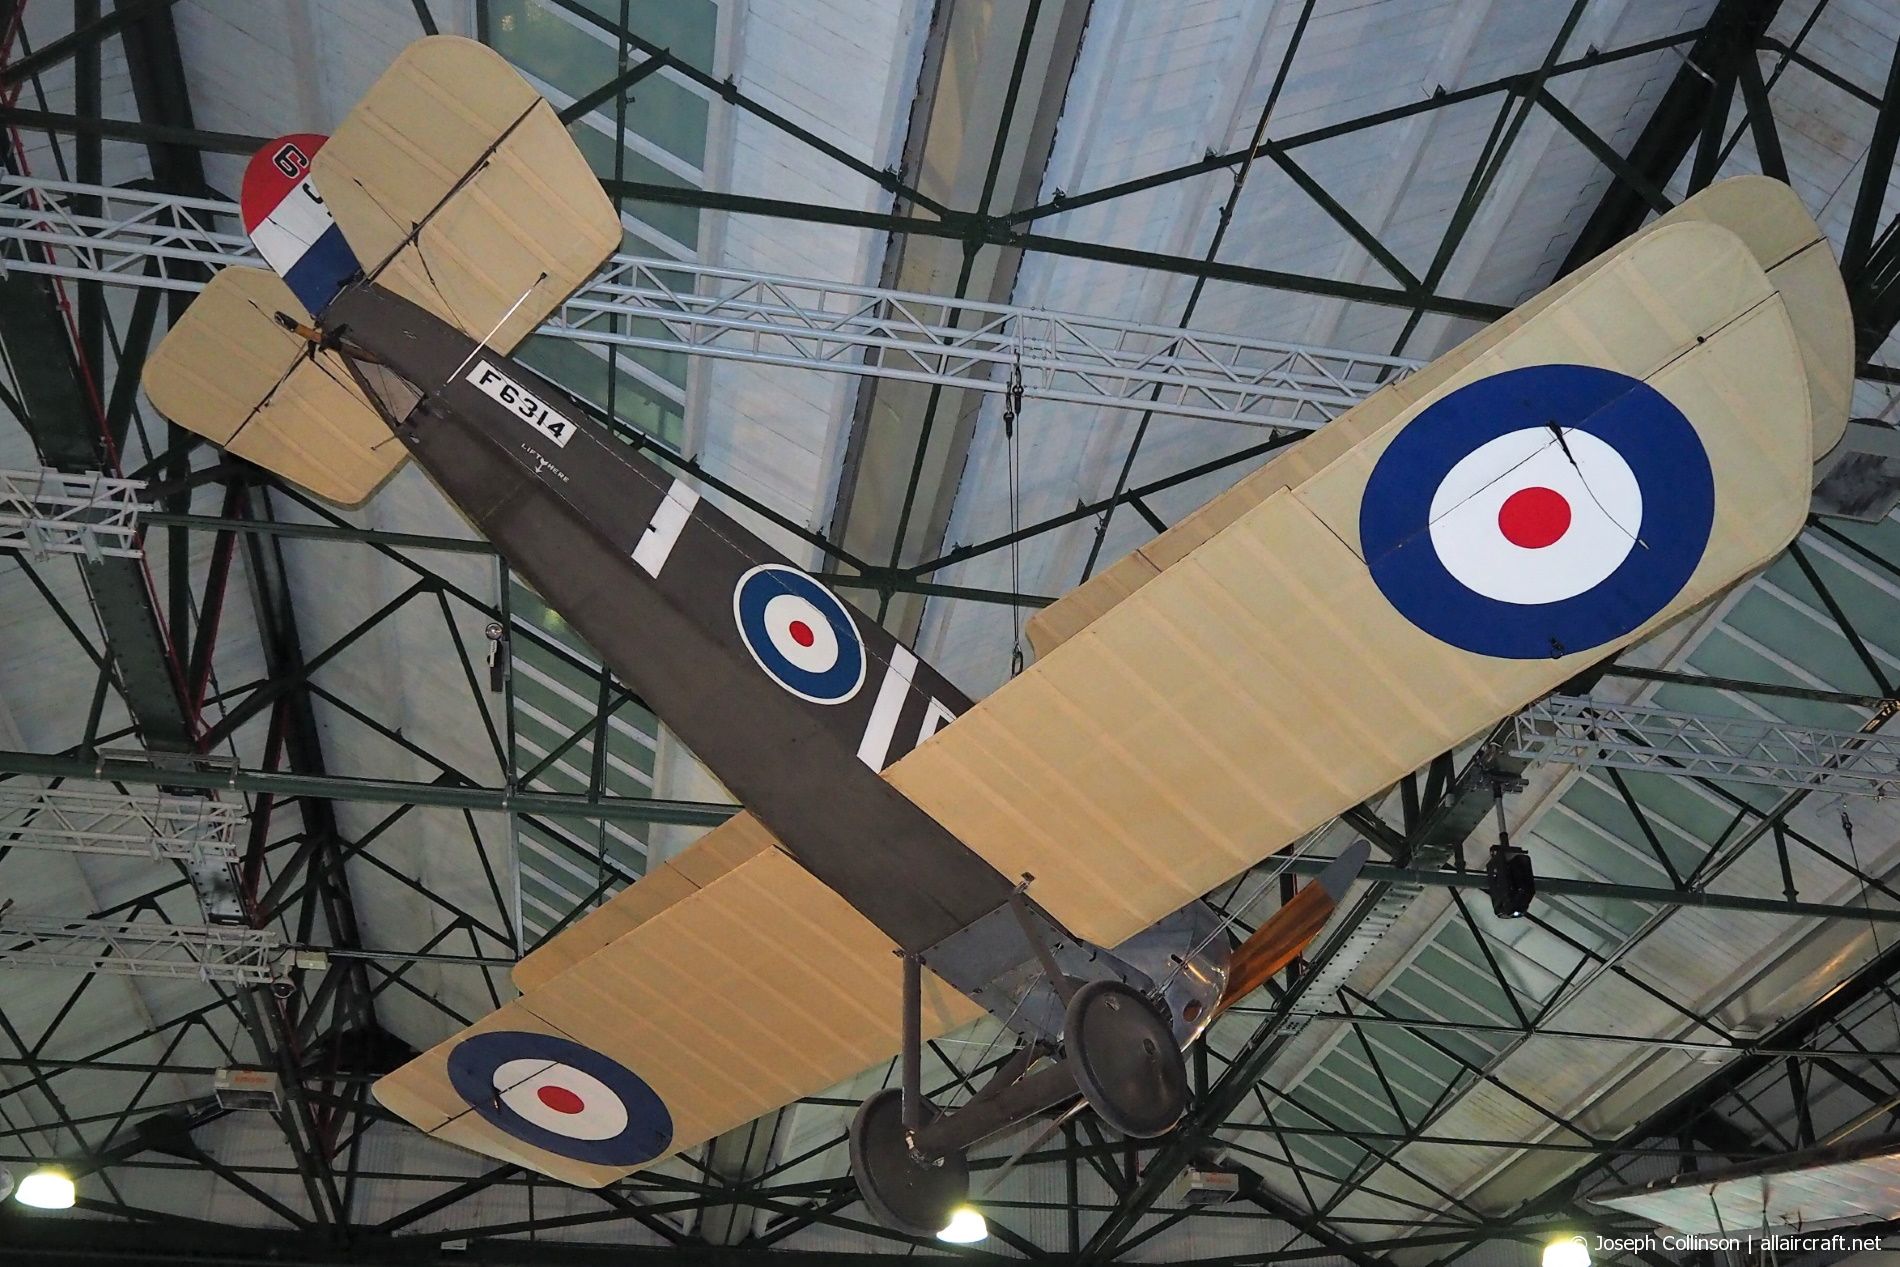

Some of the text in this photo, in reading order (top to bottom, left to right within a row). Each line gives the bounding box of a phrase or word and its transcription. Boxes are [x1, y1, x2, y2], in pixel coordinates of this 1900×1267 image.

[479, 369, 566, 438] F6314
[521, 443, 570, 483] LIFT HERE
